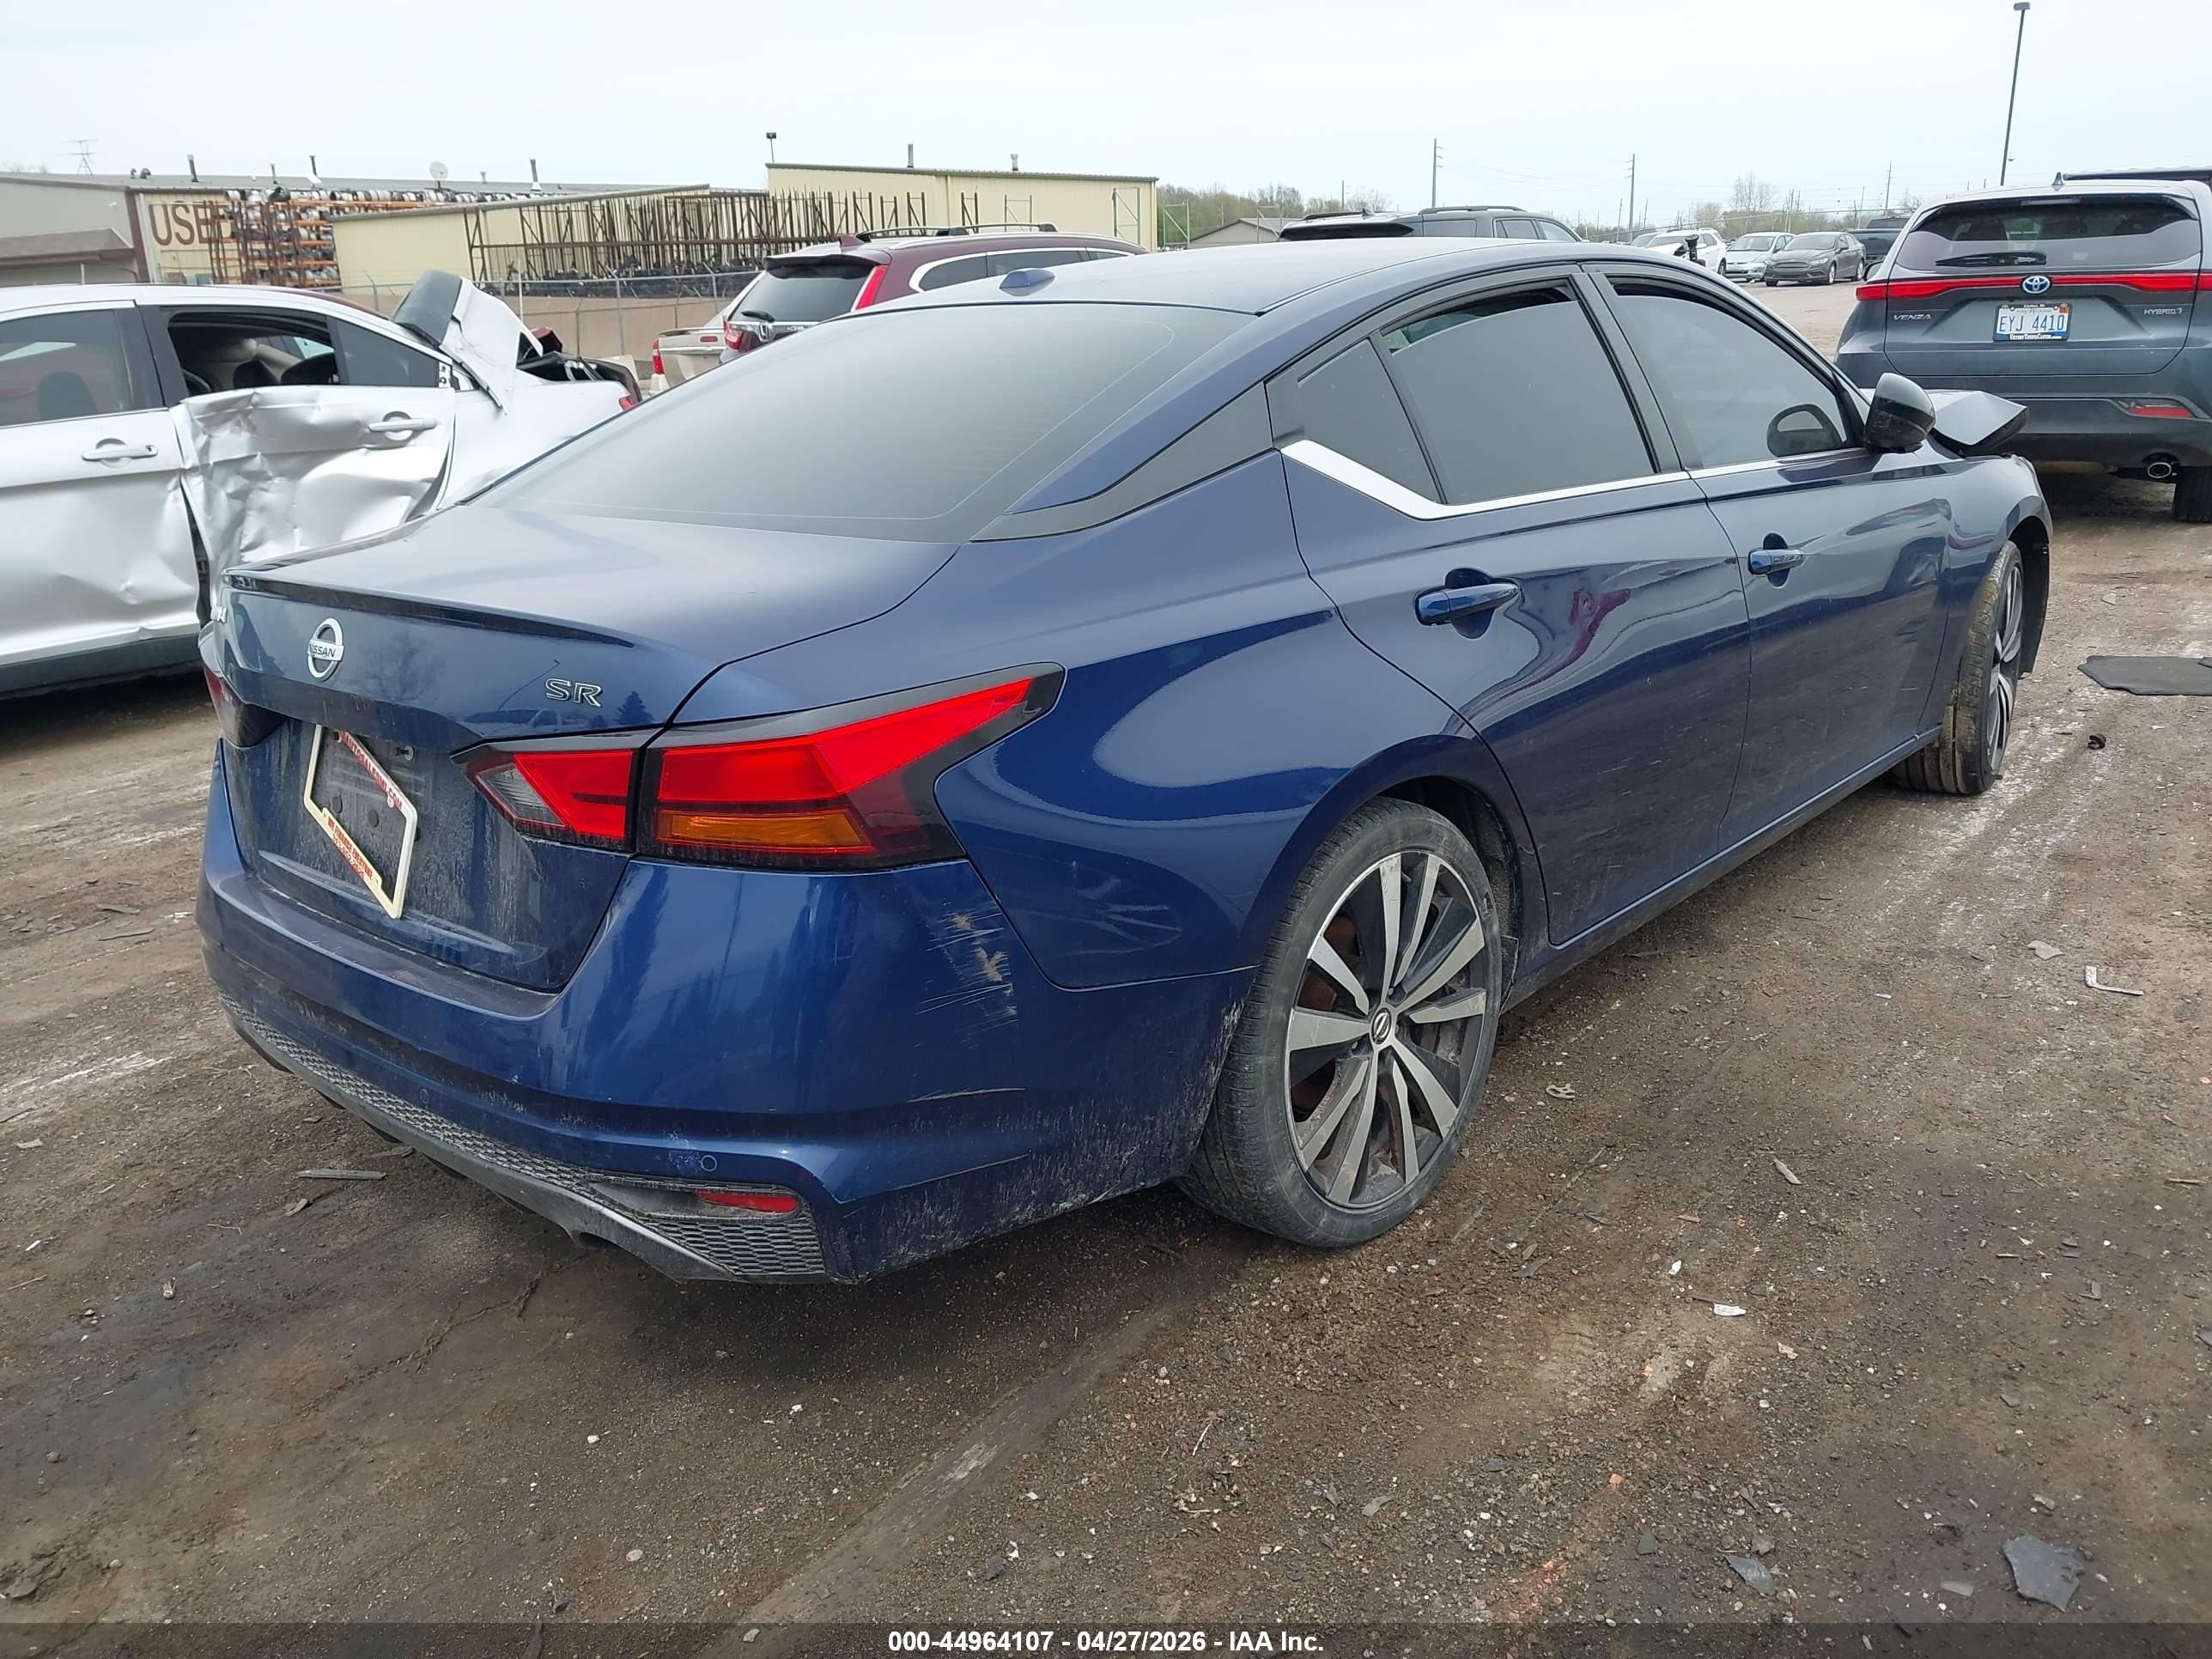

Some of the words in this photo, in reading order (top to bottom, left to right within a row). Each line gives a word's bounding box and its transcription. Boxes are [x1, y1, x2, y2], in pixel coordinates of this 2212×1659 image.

[1999, 316, 2024, 332] EYJ
[2032, 314, 2065, 331] 4410
[545, 678, 602, 708] SR
